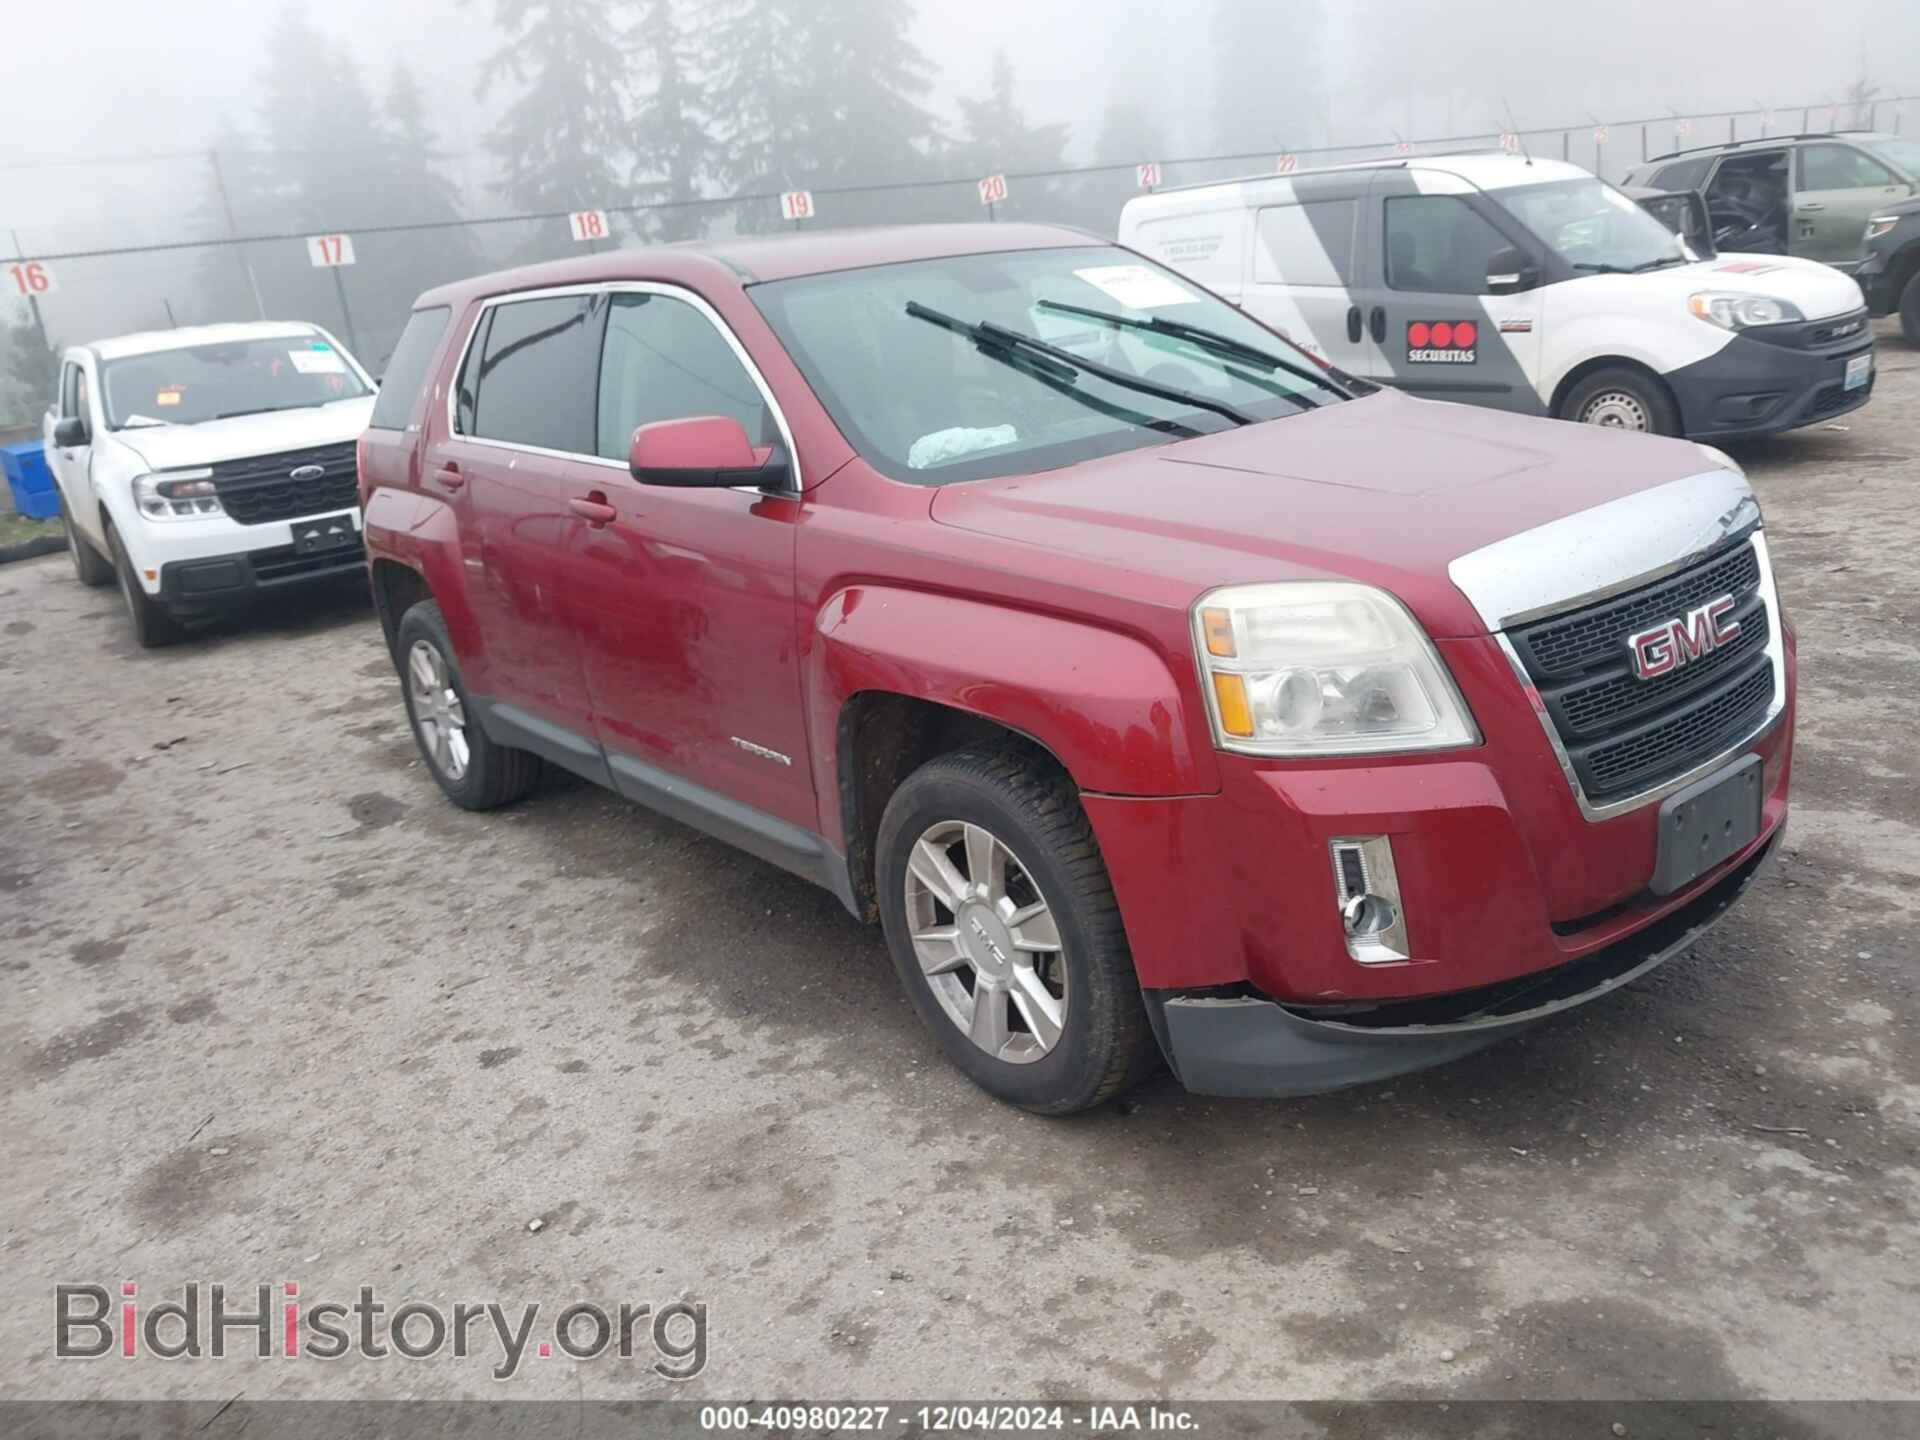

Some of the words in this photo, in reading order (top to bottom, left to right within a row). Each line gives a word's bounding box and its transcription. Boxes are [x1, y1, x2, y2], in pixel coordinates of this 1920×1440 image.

[1141, 165, 1158, 187] 21
[981, 177, 1005, 201] 20
[786, 192, 809, 217] 19
[576, 212, 602, 238] 18
[317, 235, 342, 264] 17
[9, 262, 49, 294] 16
[1408, 349, 1476, 363] SECURITAS
[1628, 593, 1742, 680] GMC
